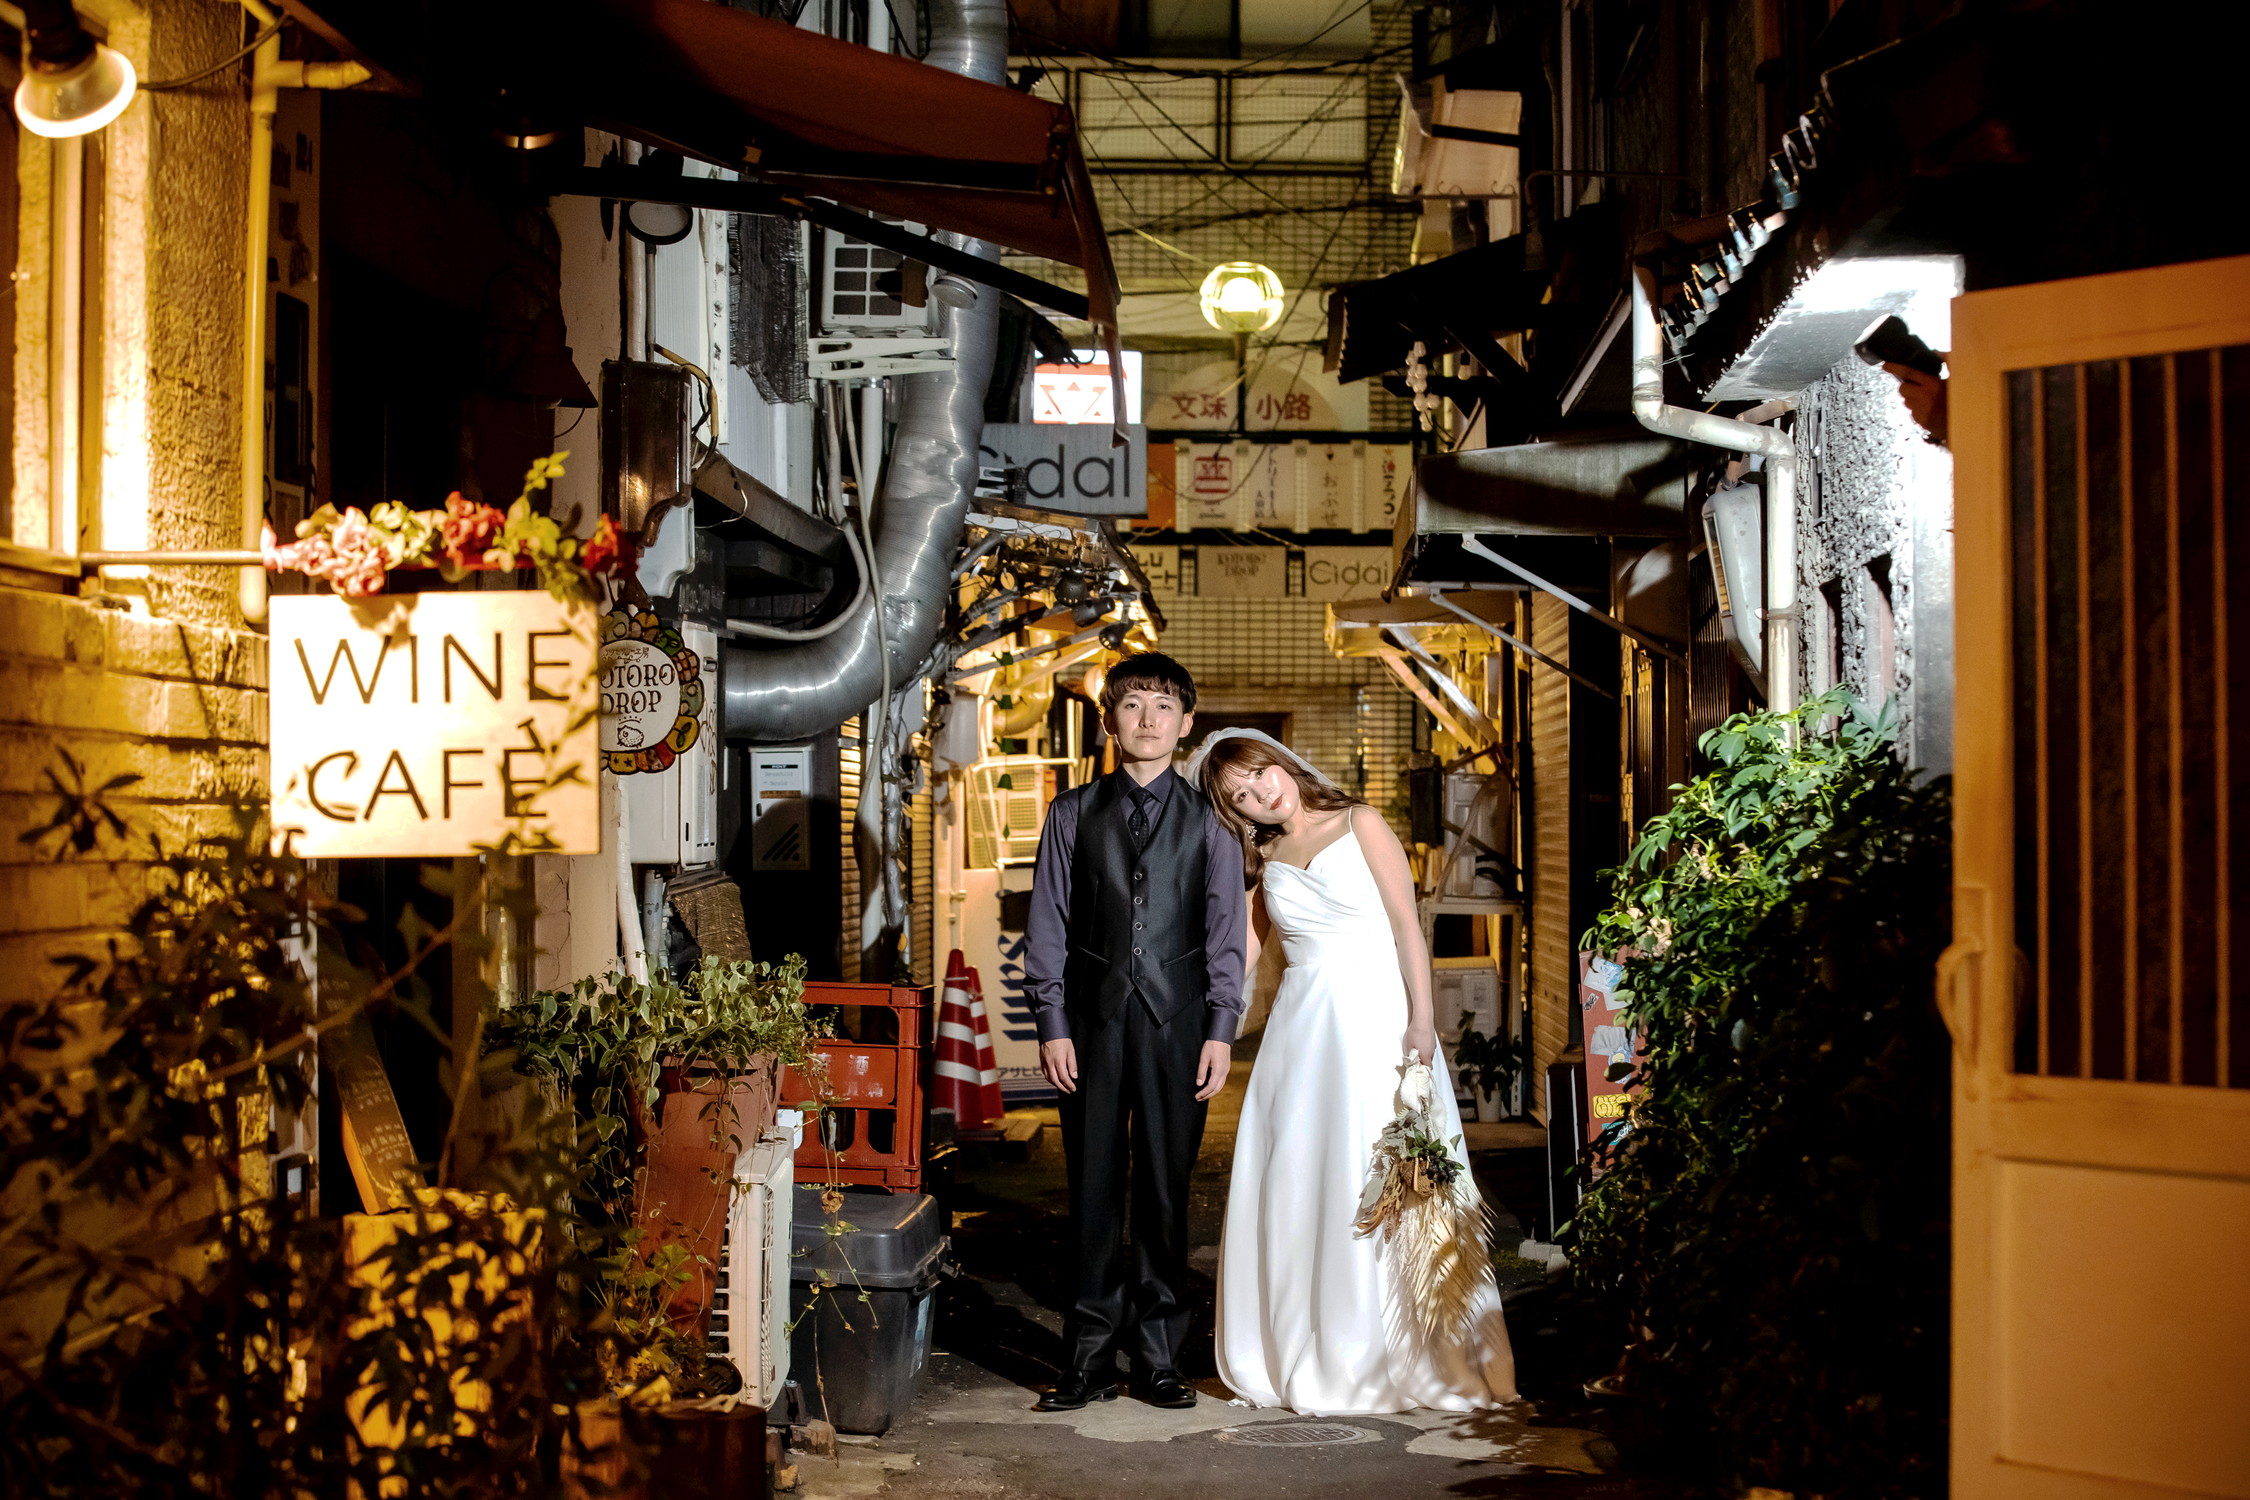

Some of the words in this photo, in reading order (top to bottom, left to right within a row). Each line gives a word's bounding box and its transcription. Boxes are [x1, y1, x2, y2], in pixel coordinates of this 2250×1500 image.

[979, 443, 1130, 498] dal
[294, 631, 572, 705] WINE
[600, 690, 662, 715] DROP
